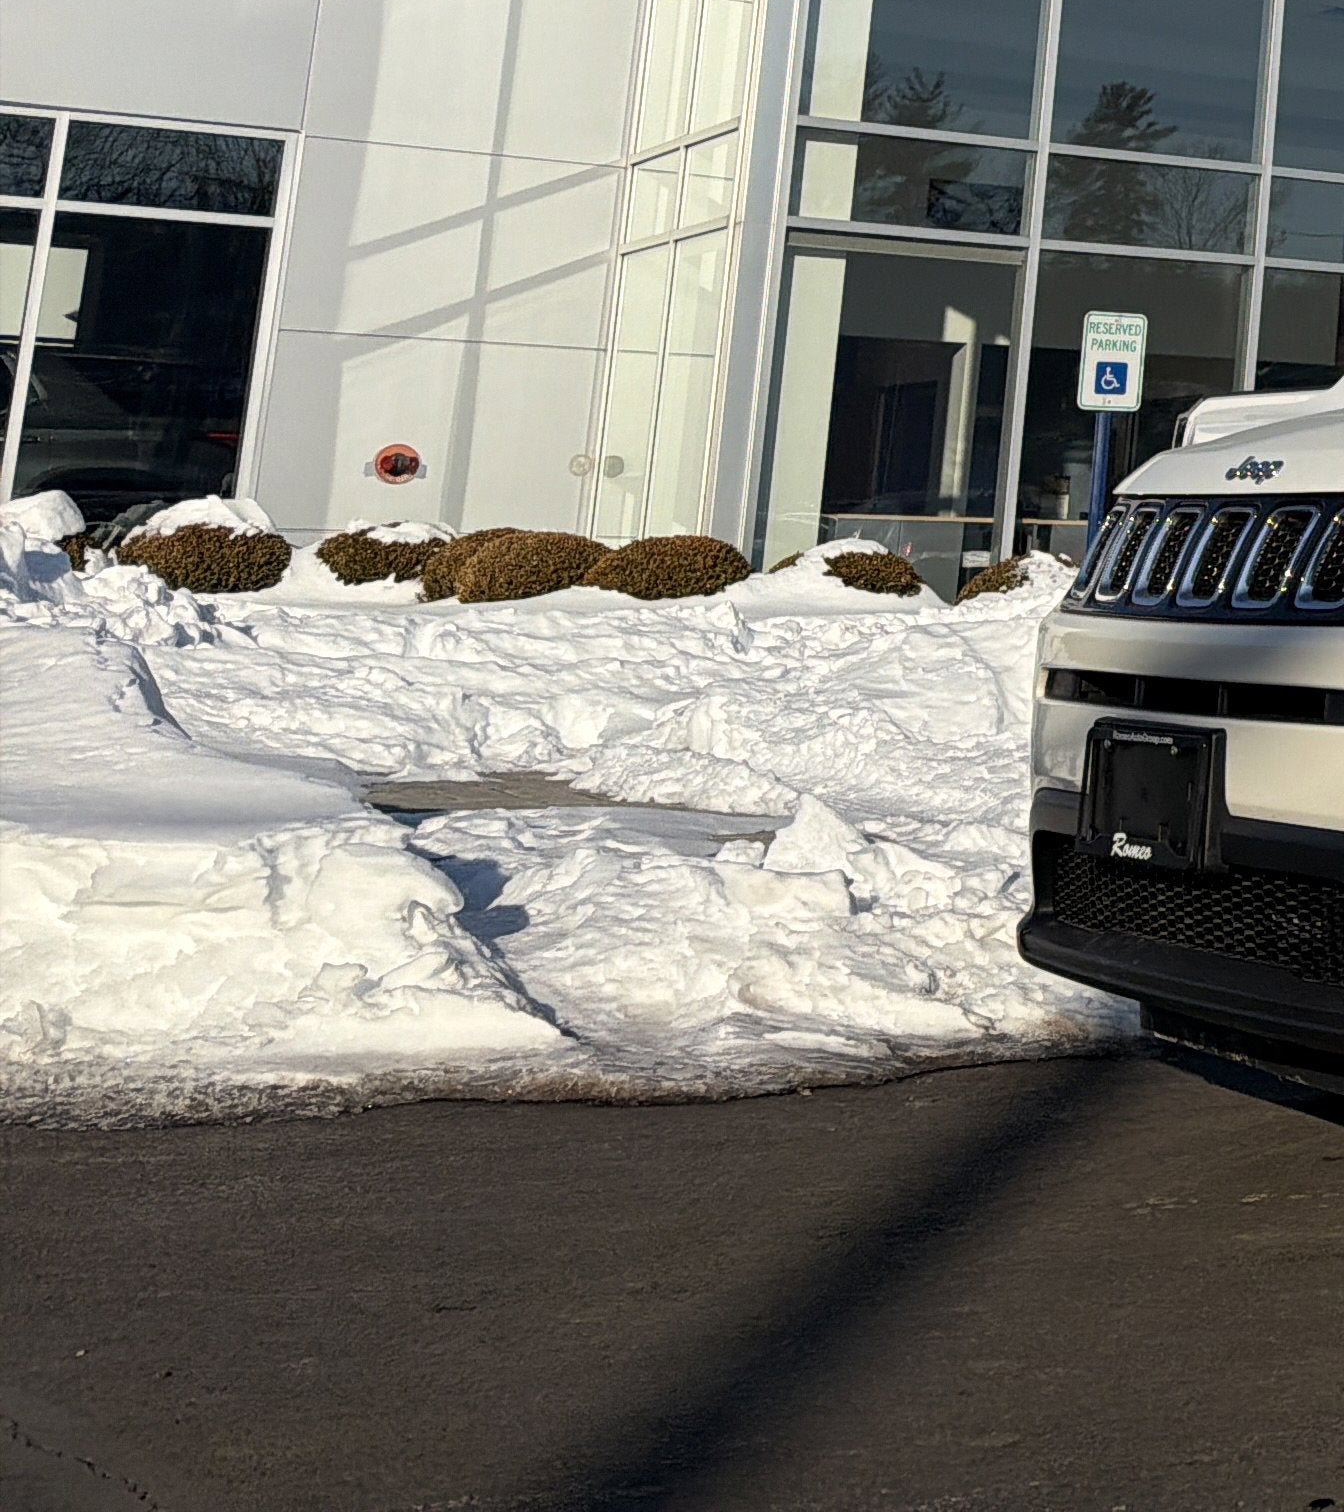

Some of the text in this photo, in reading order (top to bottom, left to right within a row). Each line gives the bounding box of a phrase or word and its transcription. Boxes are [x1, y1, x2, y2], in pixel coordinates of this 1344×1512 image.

[1088, 321, 1142, 336] RESERVED
[1090, 338, 1137, 353] PARKING
[1225, 455, 1284, 485] Jeep
[1110, 832, 1152, 860] Romeo
